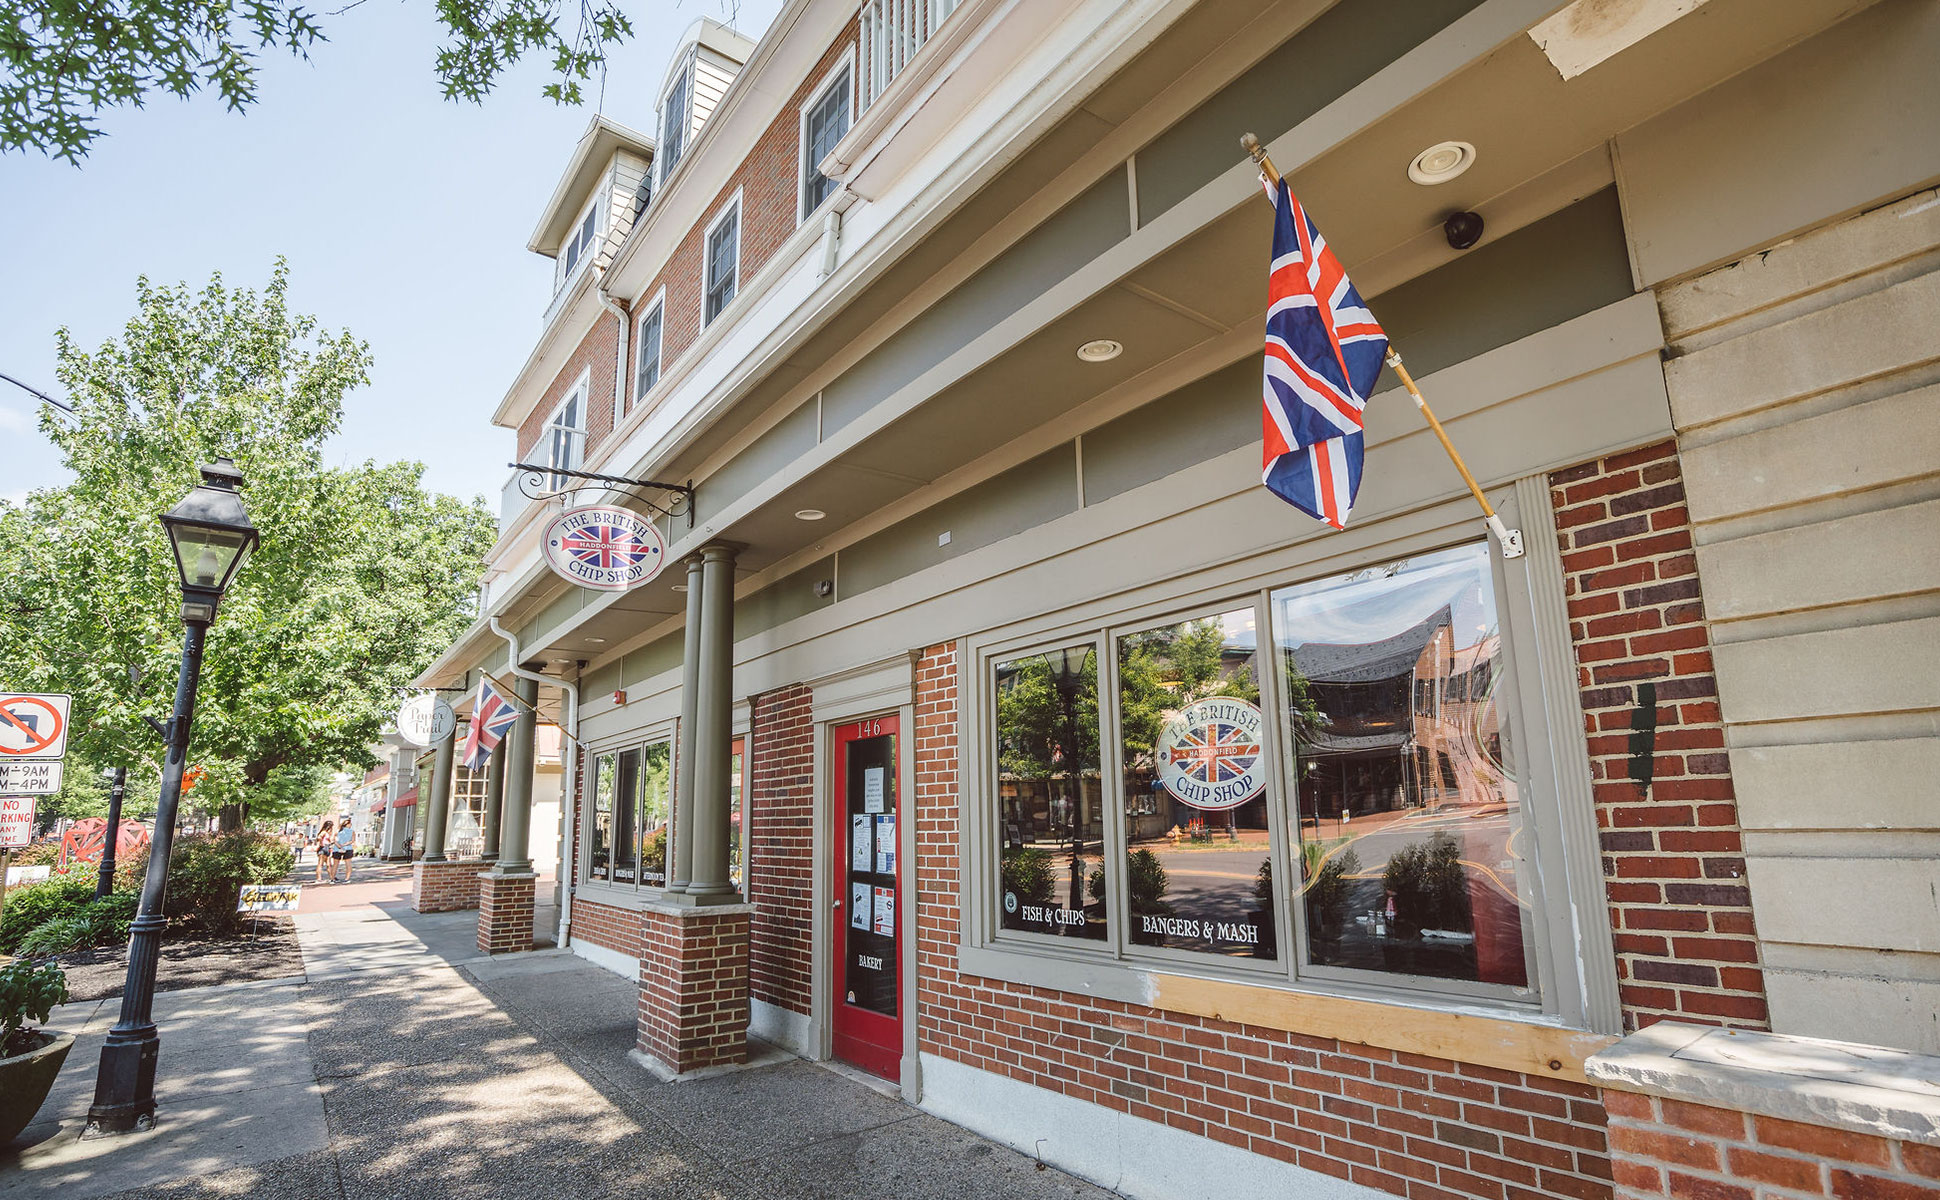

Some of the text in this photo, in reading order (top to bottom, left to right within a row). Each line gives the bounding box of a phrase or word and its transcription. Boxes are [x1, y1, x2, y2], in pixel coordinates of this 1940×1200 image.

[561, 512, 649, 538] THE BRITISH
[579, 542, 631, 551] HADDONFIELD
[569, 560, 643, 583] CHIP SHOP
[410, 706, 444, 726] Paper
[410, 719, 443, 734] Trail
[1169, 704, 1261, 739] THE BRITISH
[857, 718, 881, 739] 146
[1189, 747, 1238, 757] HADDONFIELD
[1176, 774, 1253, 803] CHIP SHOP
[3, 800, 19, 810] NO
[1022, 905, 1085, 927] FISH & CHIPS
[1142, 915, 1259, 944] BANGERS & MASH
[858, 954, 883, 971] BAKERY
